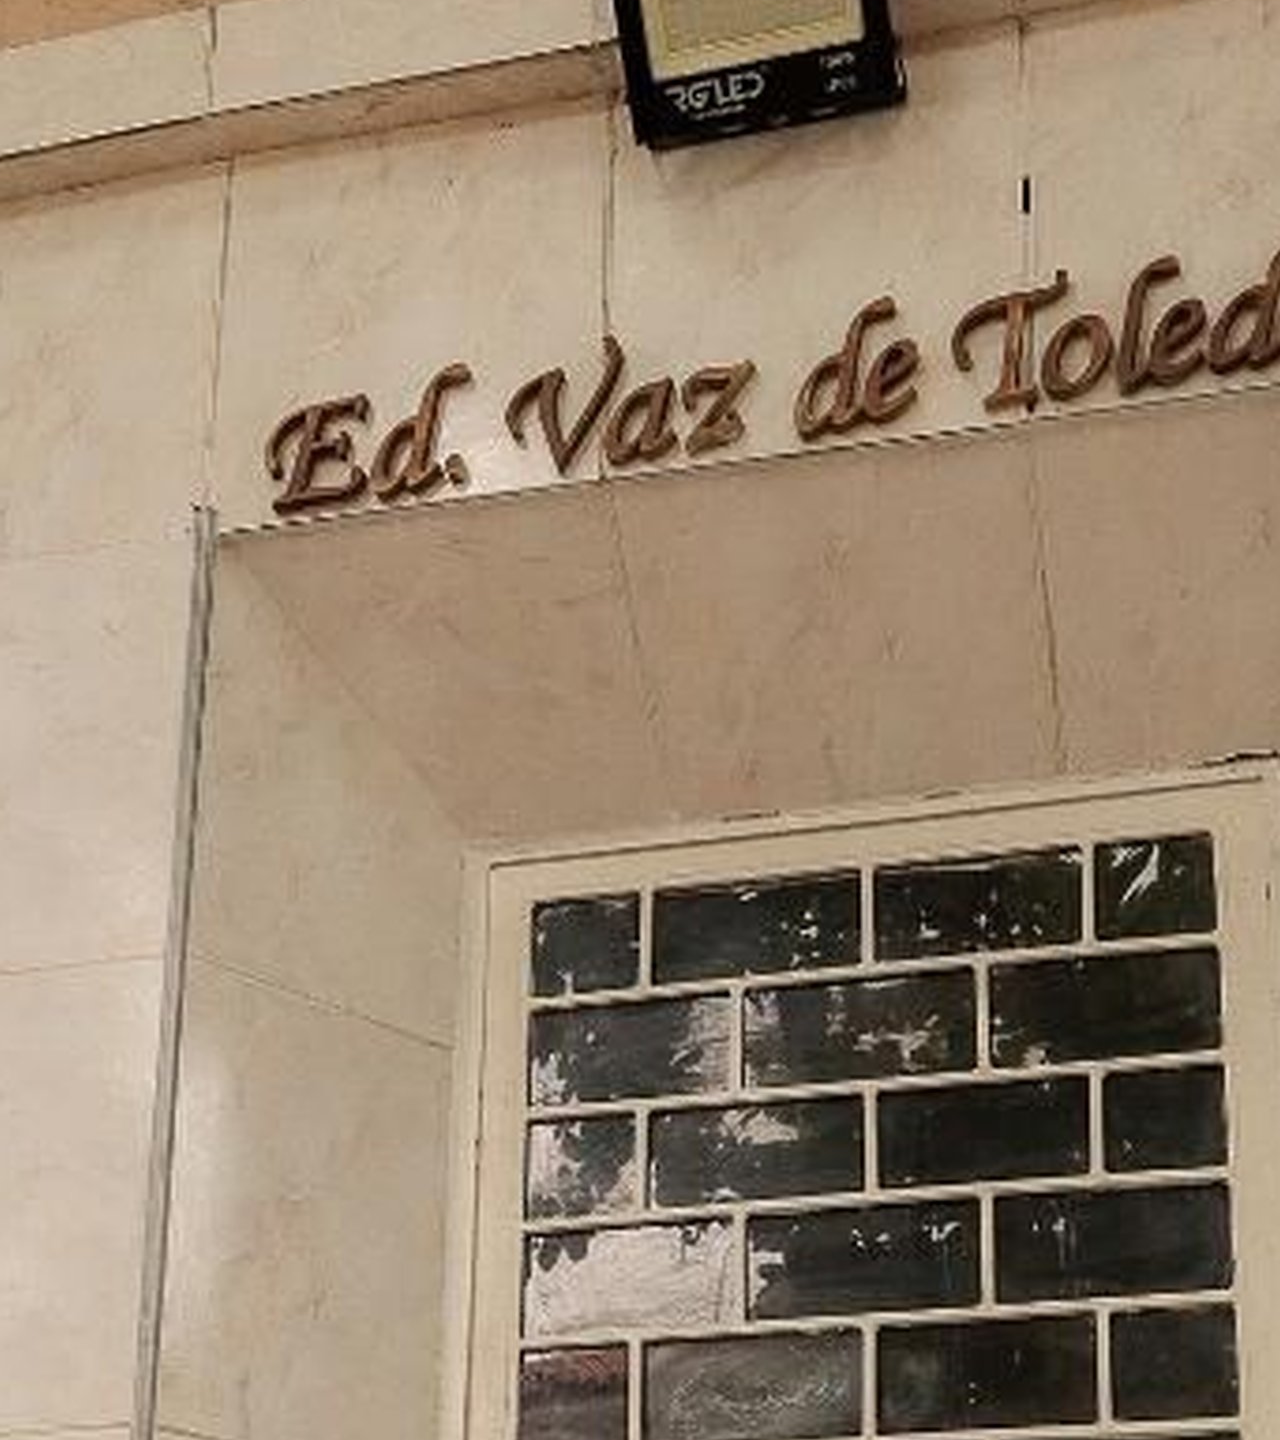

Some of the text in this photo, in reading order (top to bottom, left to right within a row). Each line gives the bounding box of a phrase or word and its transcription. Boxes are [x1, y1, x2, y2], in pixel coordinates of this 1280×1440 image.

[265, 362, 472, 514] Ed.
[505, 335, 756, 474] Vaz
[794, 296, 919, 442] de
